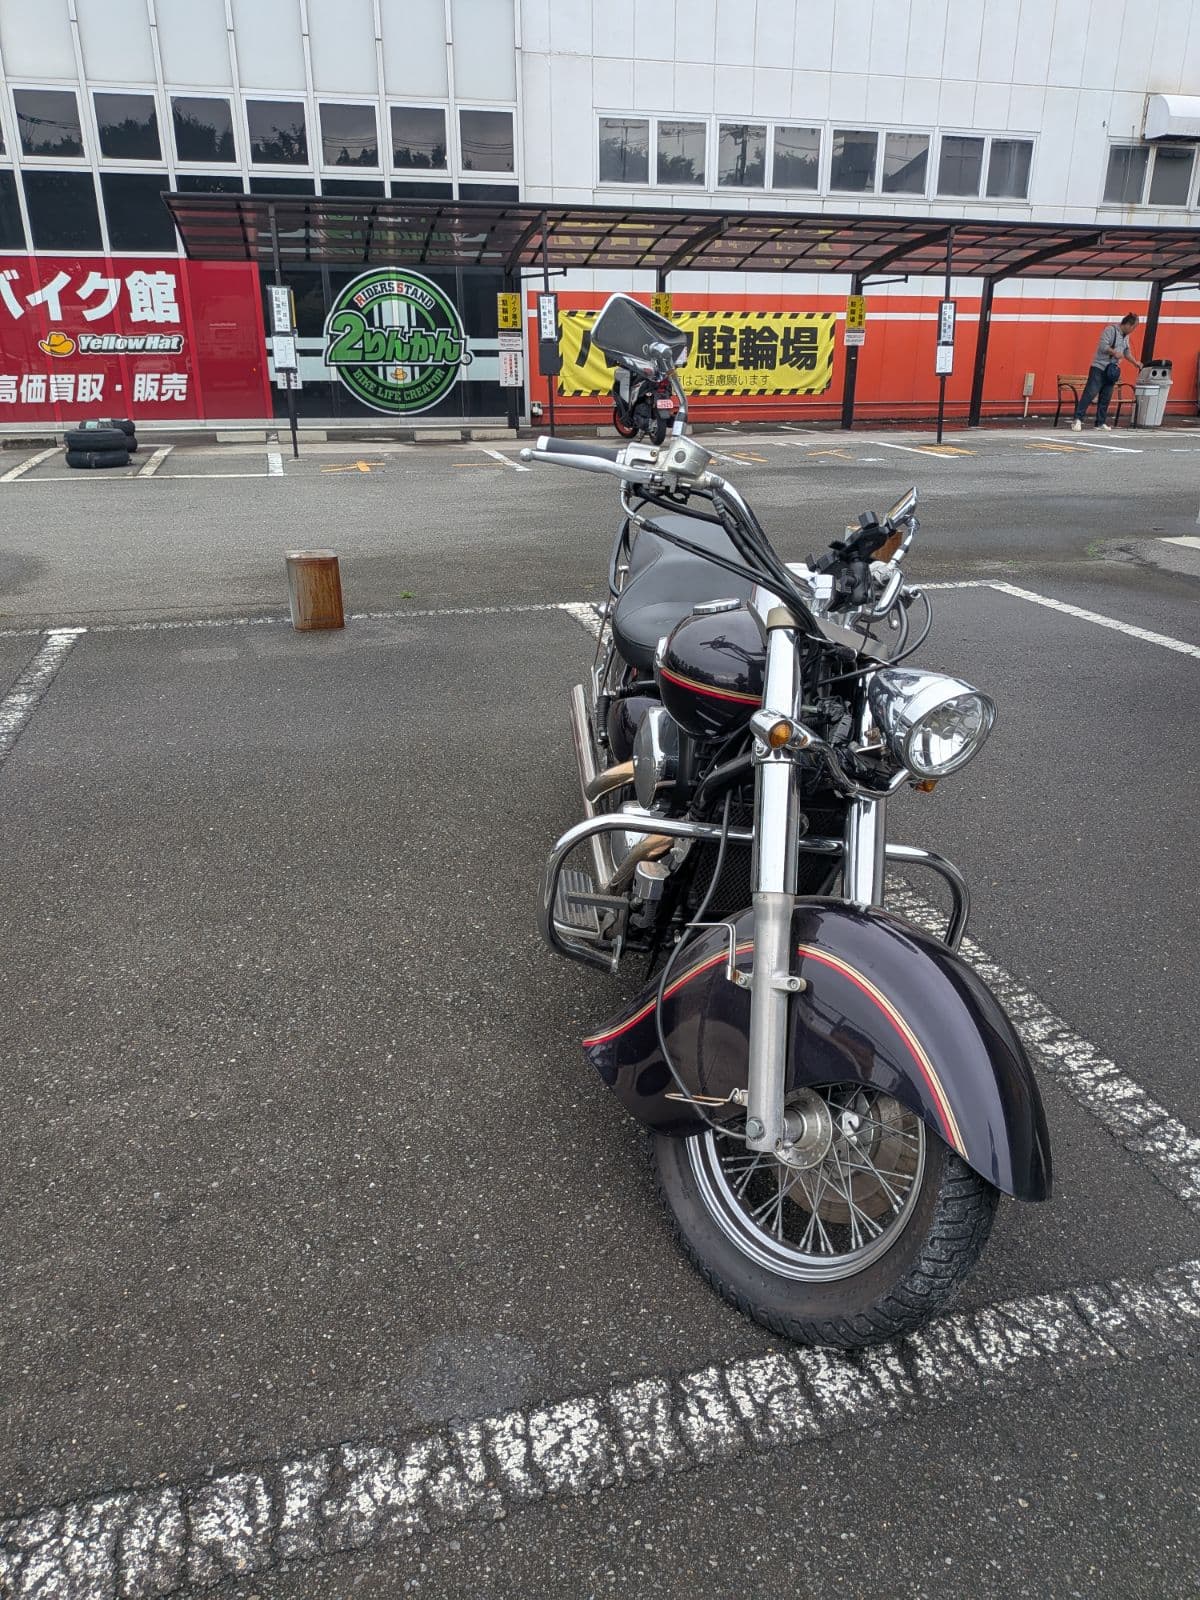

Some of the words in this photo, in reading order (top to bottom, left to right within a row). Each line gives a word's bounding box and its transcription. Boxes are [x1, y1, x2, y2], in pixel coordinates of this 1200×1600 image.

[354, 281, 395, 307] RIDERS
[396, 281, 435, 309] STAND
[330, 313, 461, 363] 2りんかん
[353, 369, 377, 392] BIKE
[377, 386, 402, 400] LIFE
[403, 369, 446, 400] CREATOR
